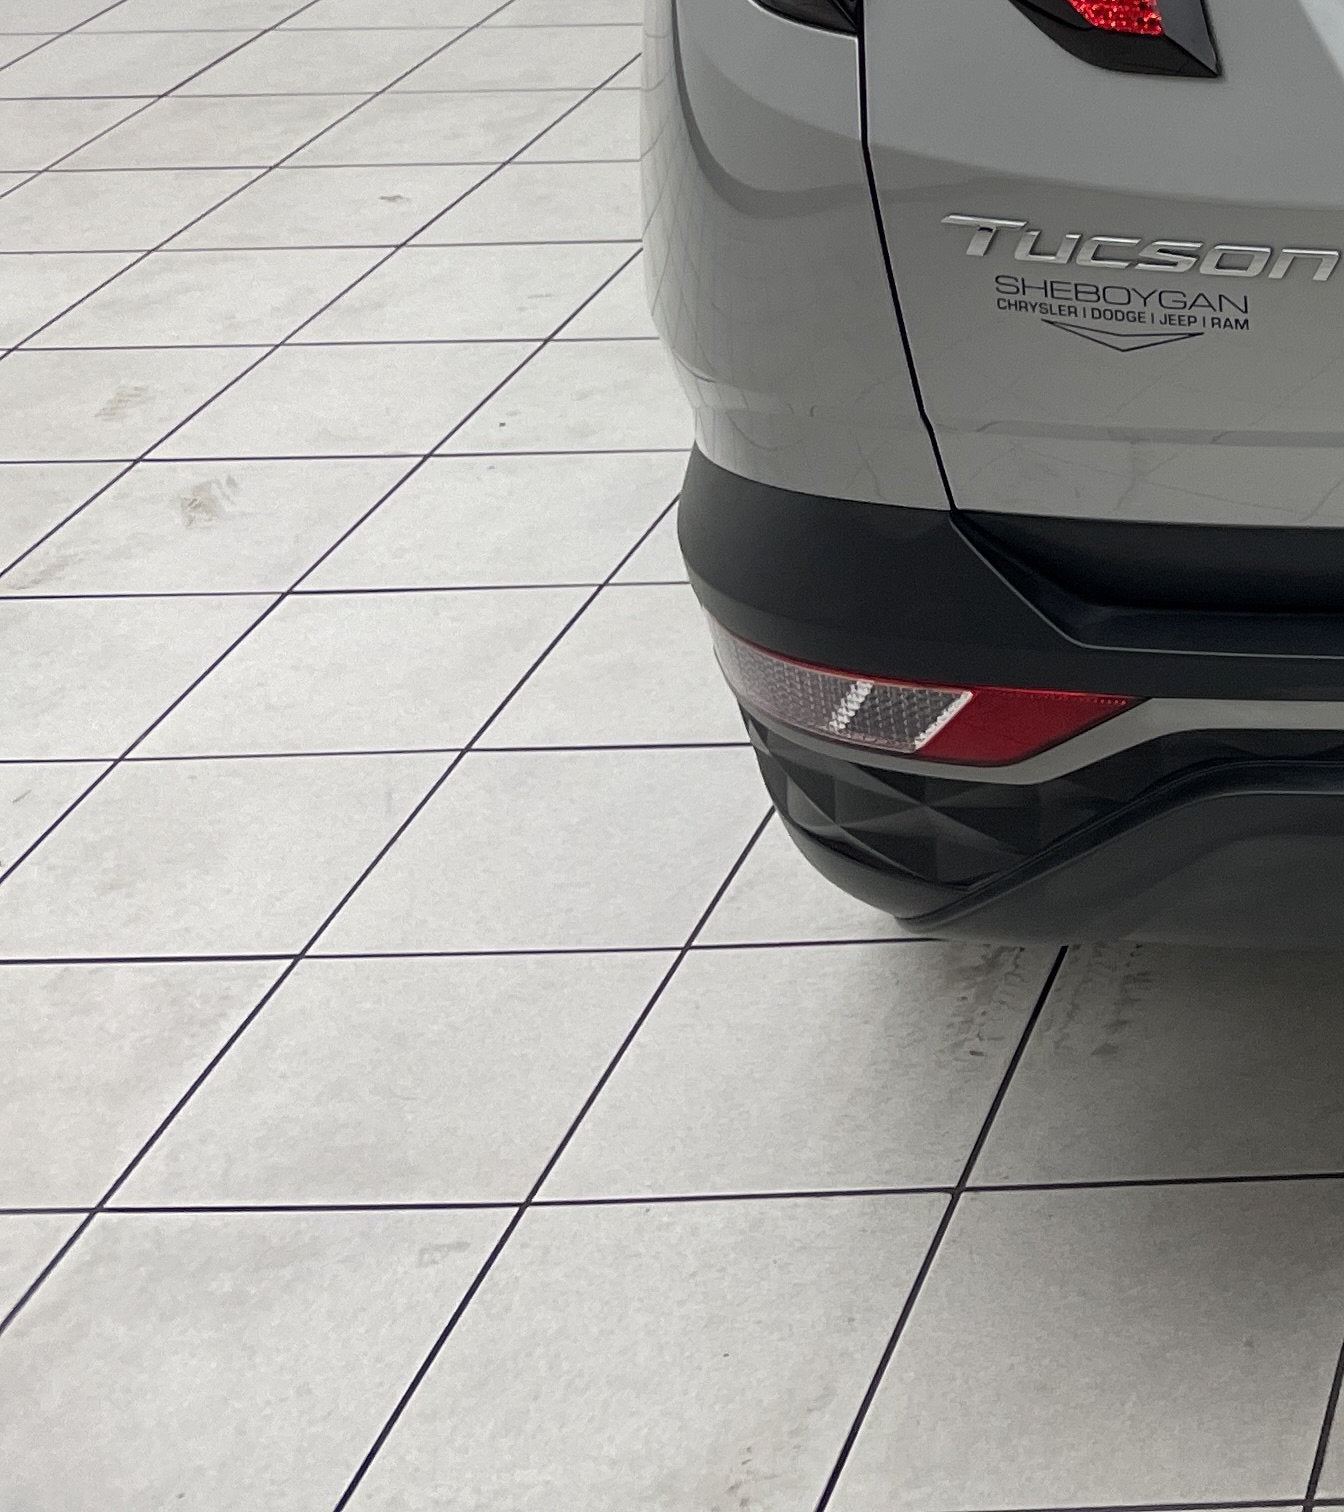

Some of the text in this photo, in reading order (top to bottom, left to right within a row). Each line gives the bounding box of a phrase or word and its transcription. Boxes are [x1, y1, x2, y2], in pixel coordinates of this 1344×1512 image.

[994, 274, 1249, 315] SHEBOYGAN
[996, 297, 1250, 330] CHRYSLER DODGE JEEP RAM
